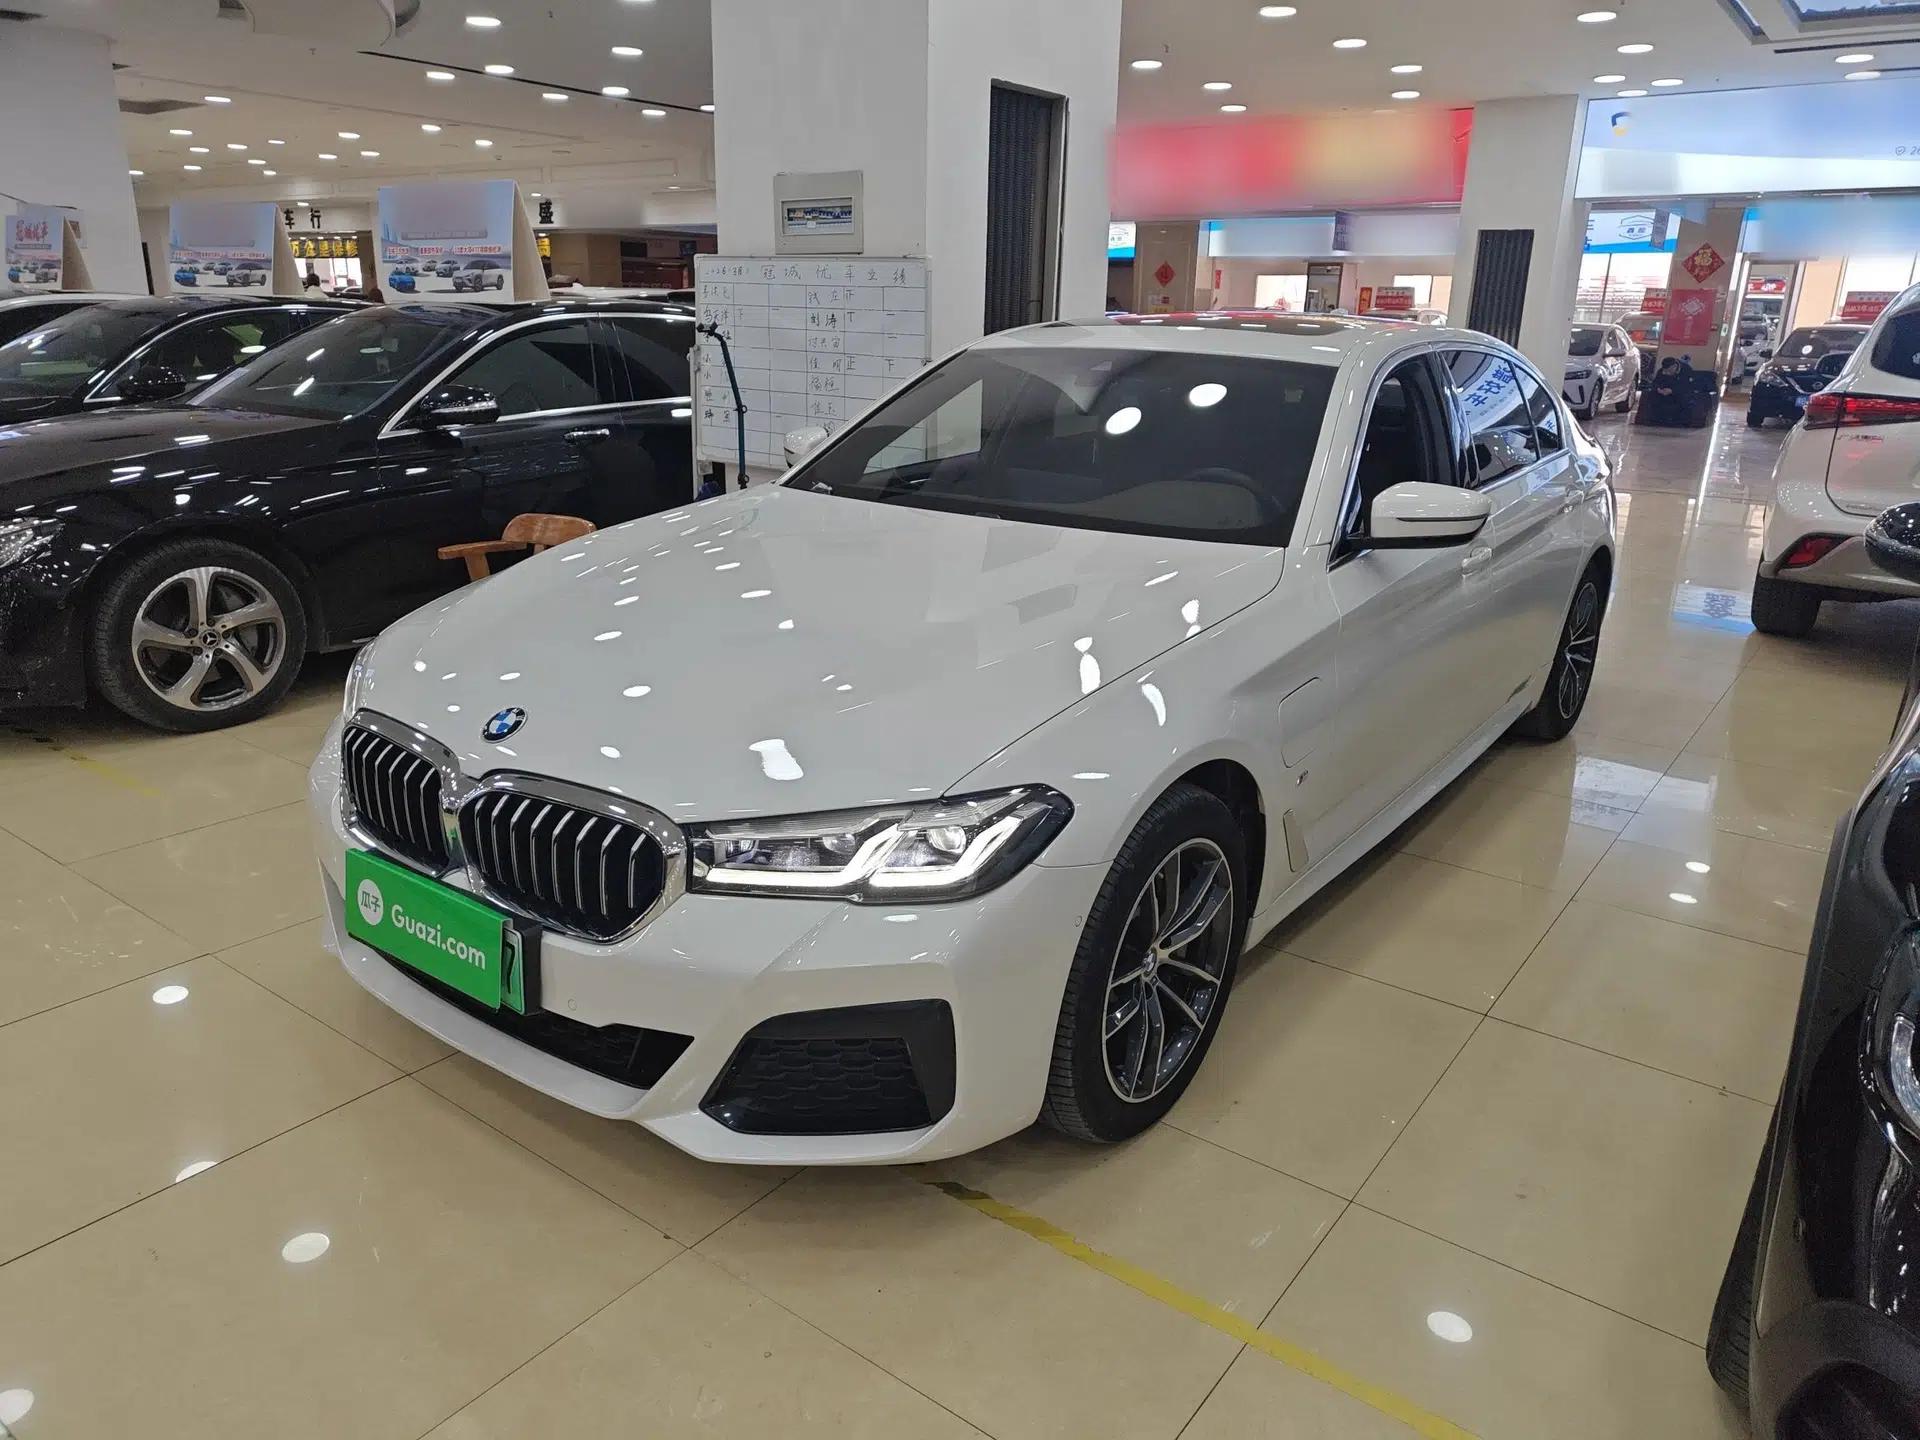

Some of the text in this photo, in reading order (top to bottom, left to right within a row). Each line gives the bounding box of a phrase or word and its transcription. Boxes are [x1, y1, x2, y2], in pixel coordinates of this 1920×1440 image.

[284, 208, 321, 229] 车行
[359, 888, 381, 915] 瓜子
[391, 906, 486, 970] Guazi.com
